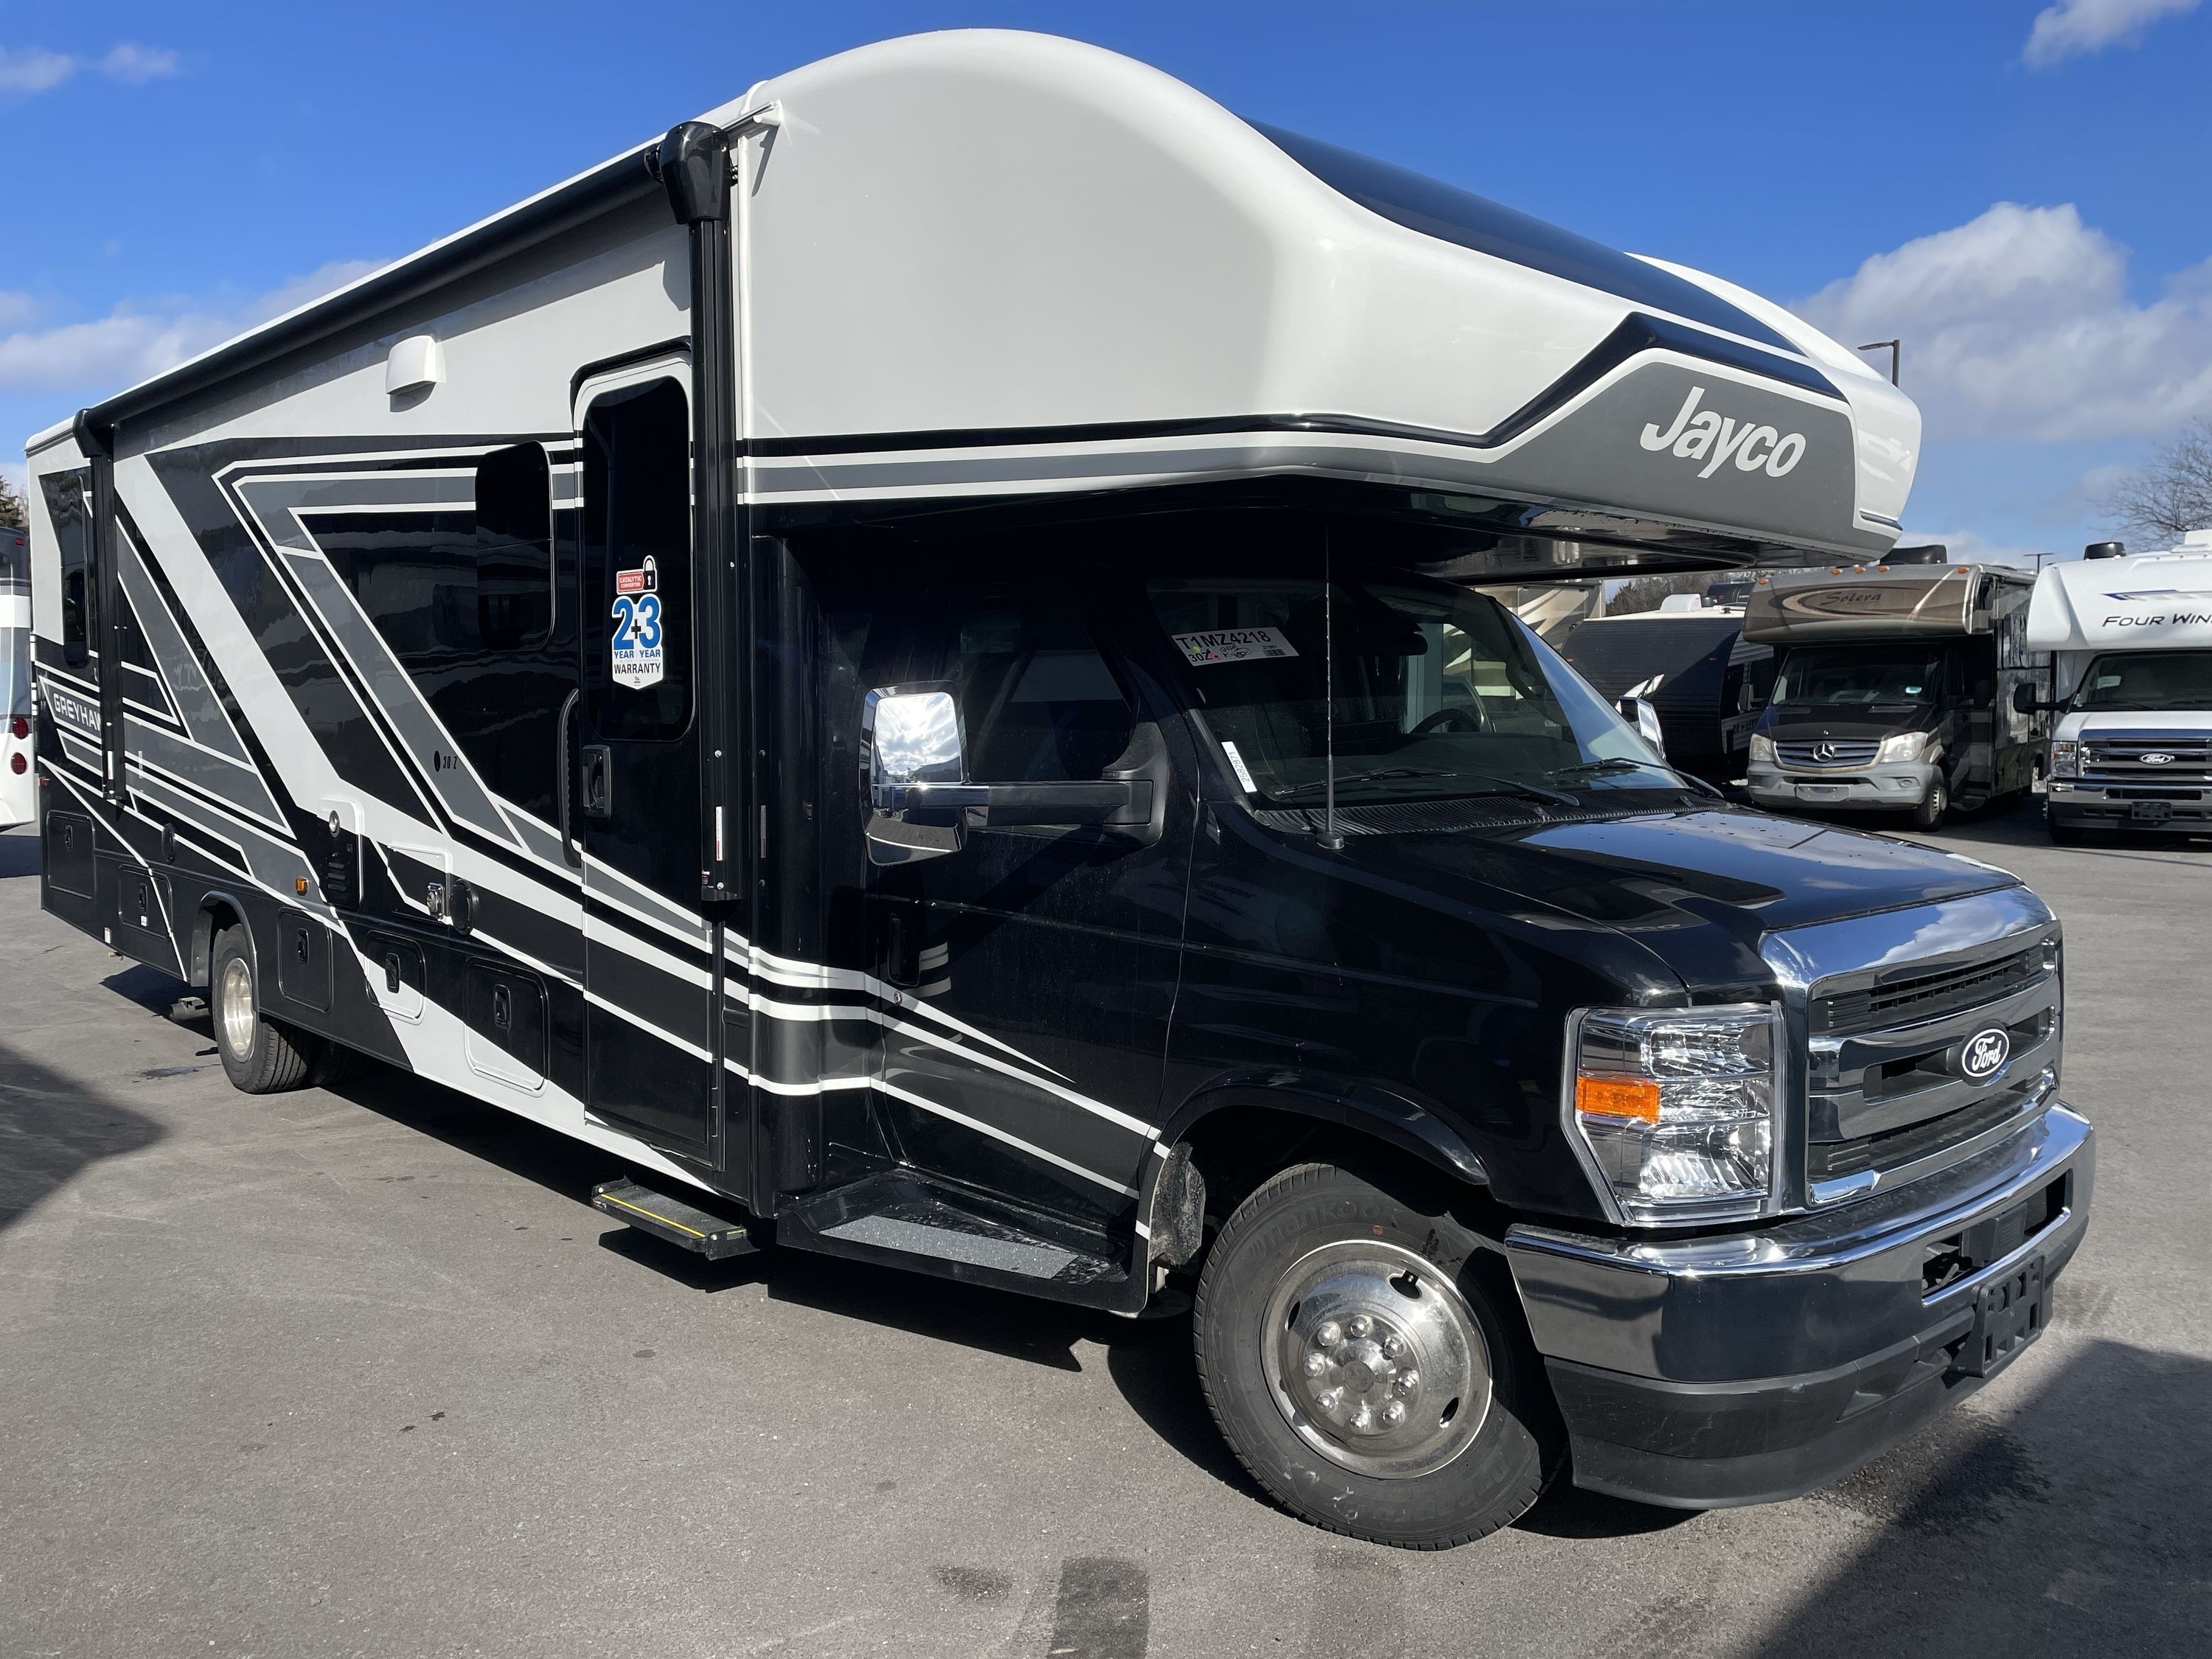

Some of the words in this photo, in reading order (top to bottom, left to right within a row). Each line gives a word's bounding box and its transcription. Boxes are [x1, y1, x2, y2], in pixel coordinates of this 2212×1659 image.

[1639, 386, 1806, 479] Jayco
[619, 575, 642, 583] CATALYTIC
[1819, 591, 1882, 606] Solera
[2102, 616, 2166, 627] FOUR
[2172, 613, 2212, 625] WIN
[1175, 630, 1272, 650] T1MZ4218
[614, 650, 634, 659] YEAR
[639, 649, 661, 658] YEAR
[614, 663, 661, 674] WARRANTY
[1229, 752, 1250, 782] 2582871
[1972, 1035, 2002, 1071] Ford
